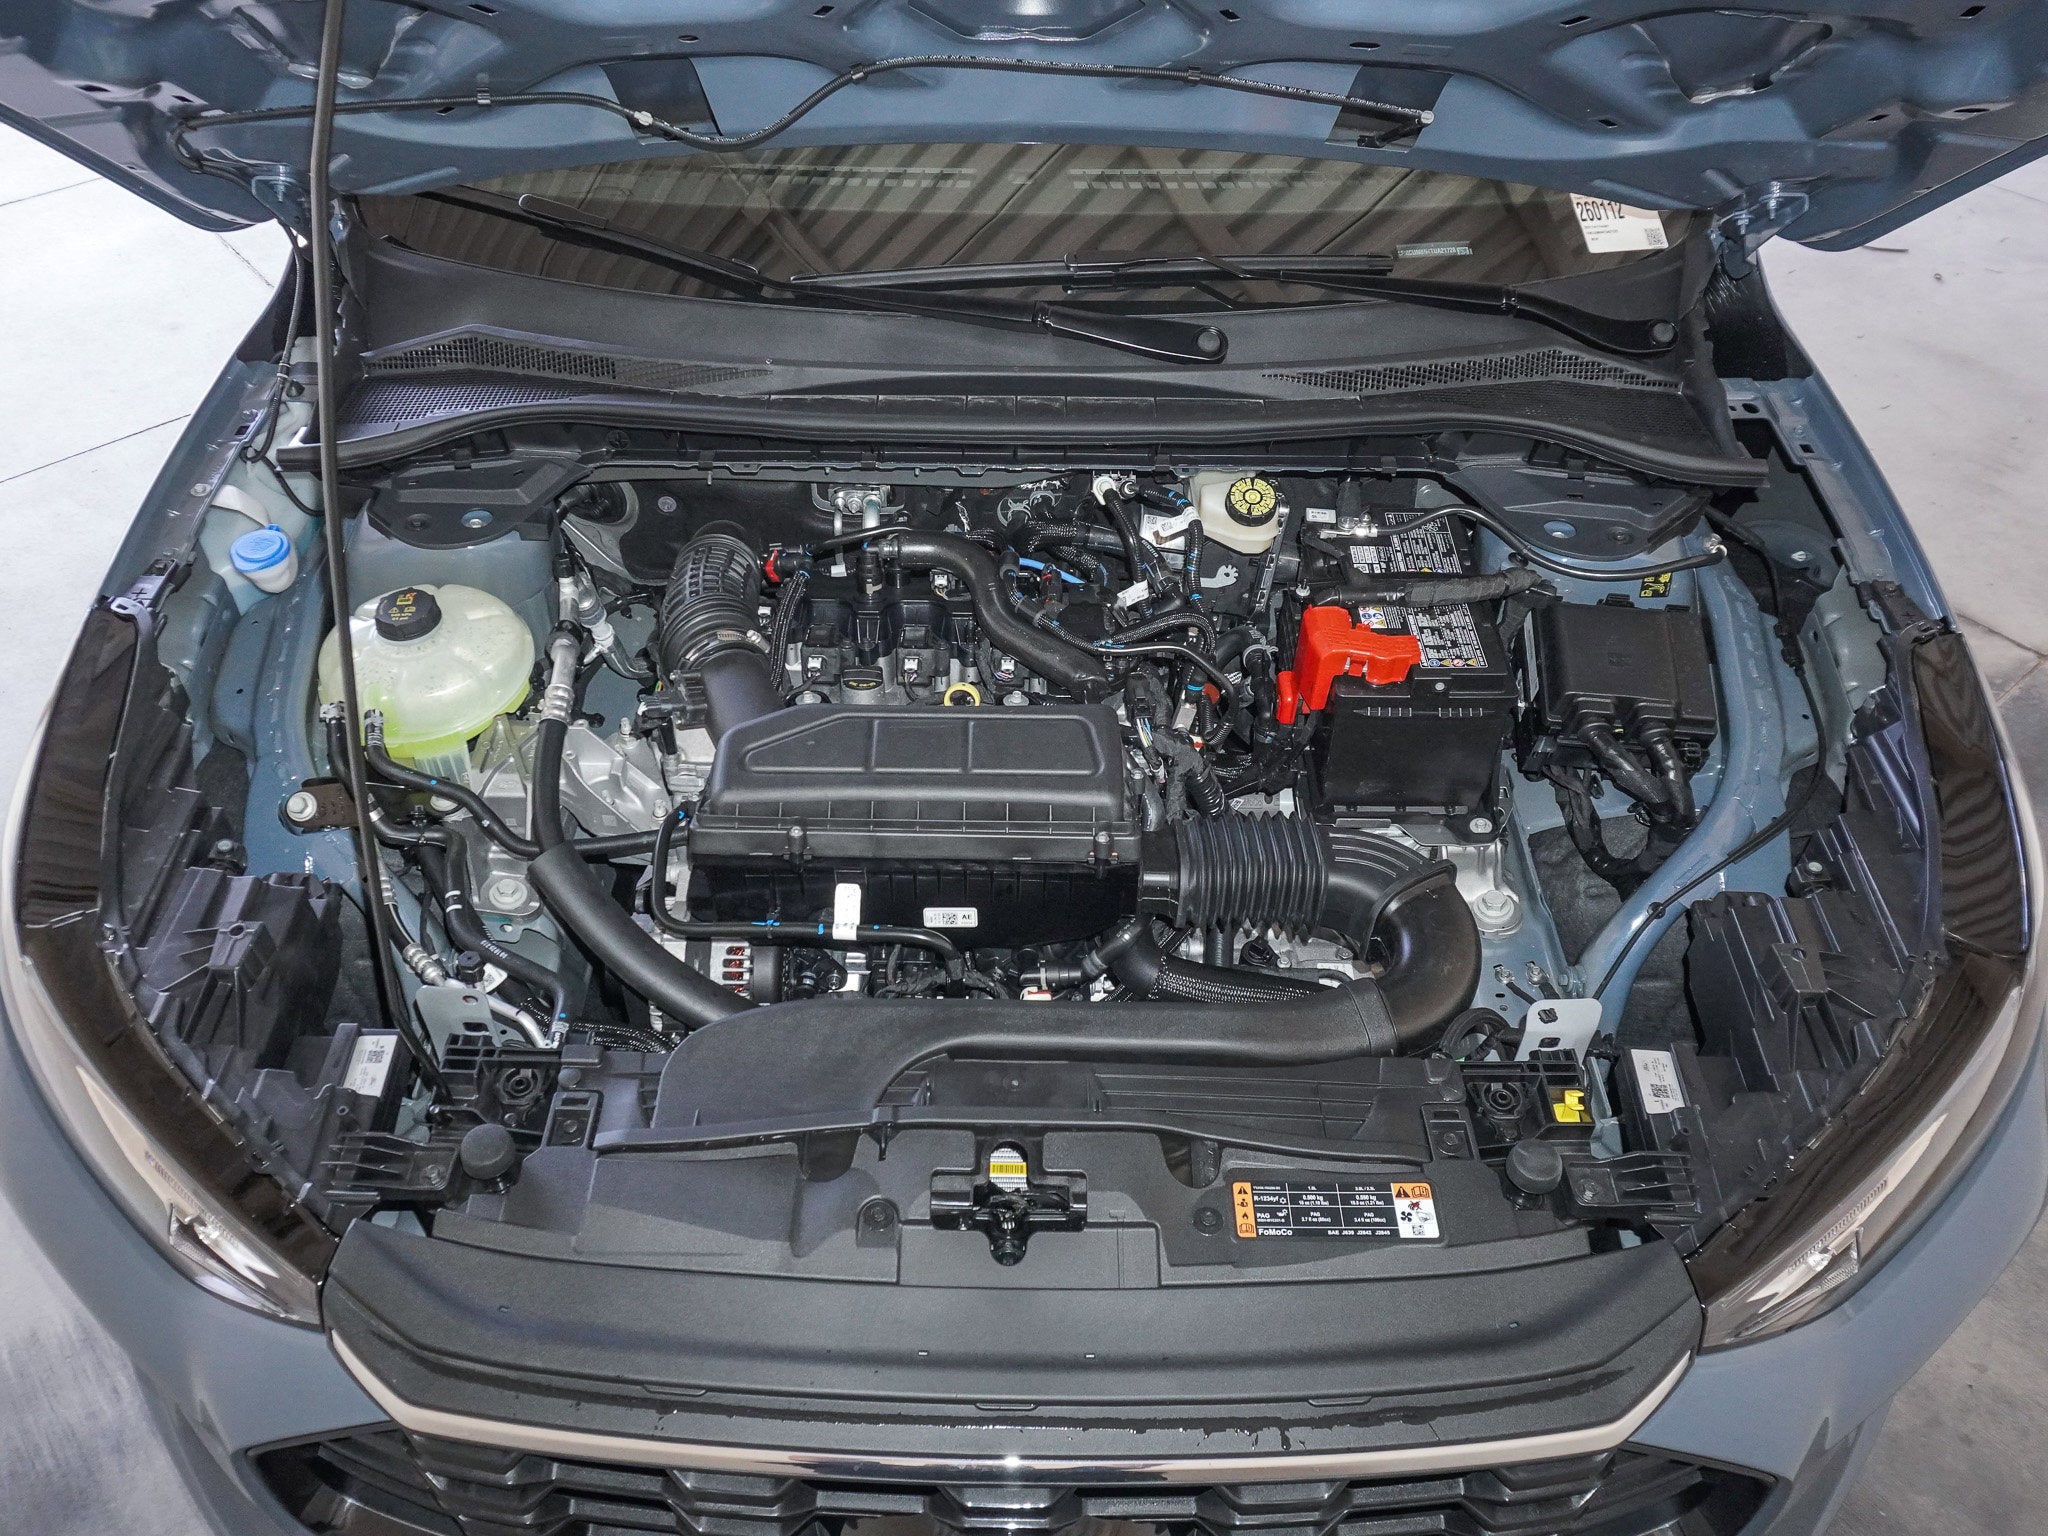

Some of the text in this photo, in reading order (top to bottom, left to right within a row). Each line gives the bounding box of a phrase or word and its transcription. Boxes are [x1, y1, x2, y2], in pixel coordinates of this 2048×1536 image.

[1576, 200, 1625, 221] 260112
[1253, 1195, 1279, 1203] R-1234yf
[1258, 1228, 1293, 1236] FoMoCo
